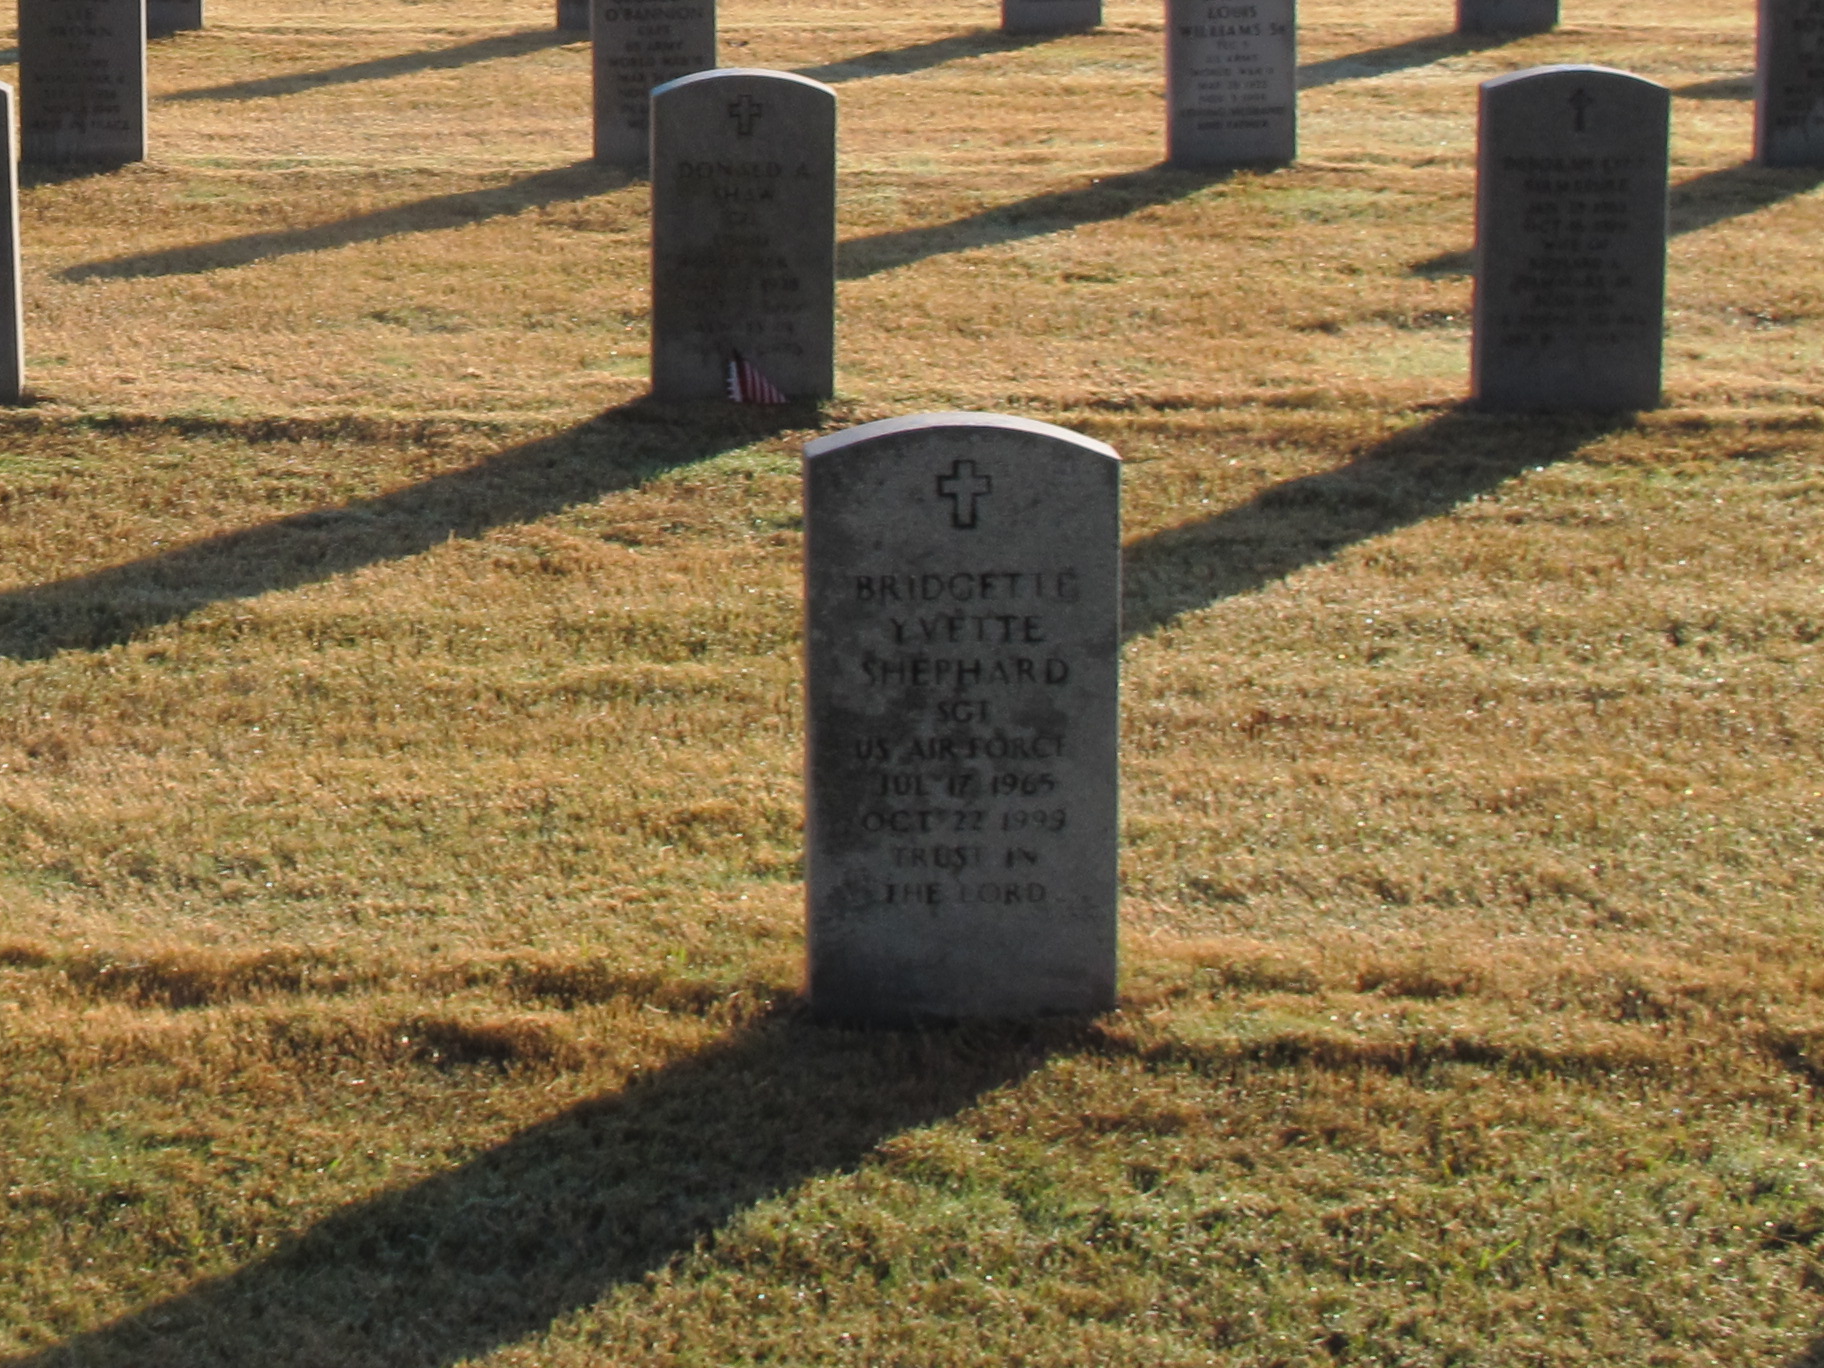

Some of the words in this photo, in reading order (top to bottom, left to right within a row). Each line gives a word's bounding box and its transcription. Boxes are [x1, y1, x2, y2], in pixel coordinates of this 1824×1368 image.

[1206, 6, 1257, 20] LOUIS
[1178, 23, 1262, 38] WILLIAMS
[677, 161, 783, 179] DONALD
[795, 161, 812, 180] A
[855, 571, 1081, 603] BRIDGETTE
[888, 614, 1047, 645] YVETTE
[860, 658, 1070, 687] SHEPHARD
[936, 699, 990, 724] SGT
[855, 736, 890, 760] US
[909, 736, 957, 761] AIR
[968, 734, 1067, 760] FORCE
[879, 773, 929, 797] JUL
[948, 773, 975, 797] 17
[991, 772, 1057, 796] 1965
[862, 809, 933, 833] OCT
[953, 809, 987, 832] 22
[1000, 808, 1068, 833] 1999
[892, 845, 984, 869] TRUST
[1005, 846, 1040, 869] IN
[884, 883, 942, 906] THE
[961, 882, 1047, 905] LORD
